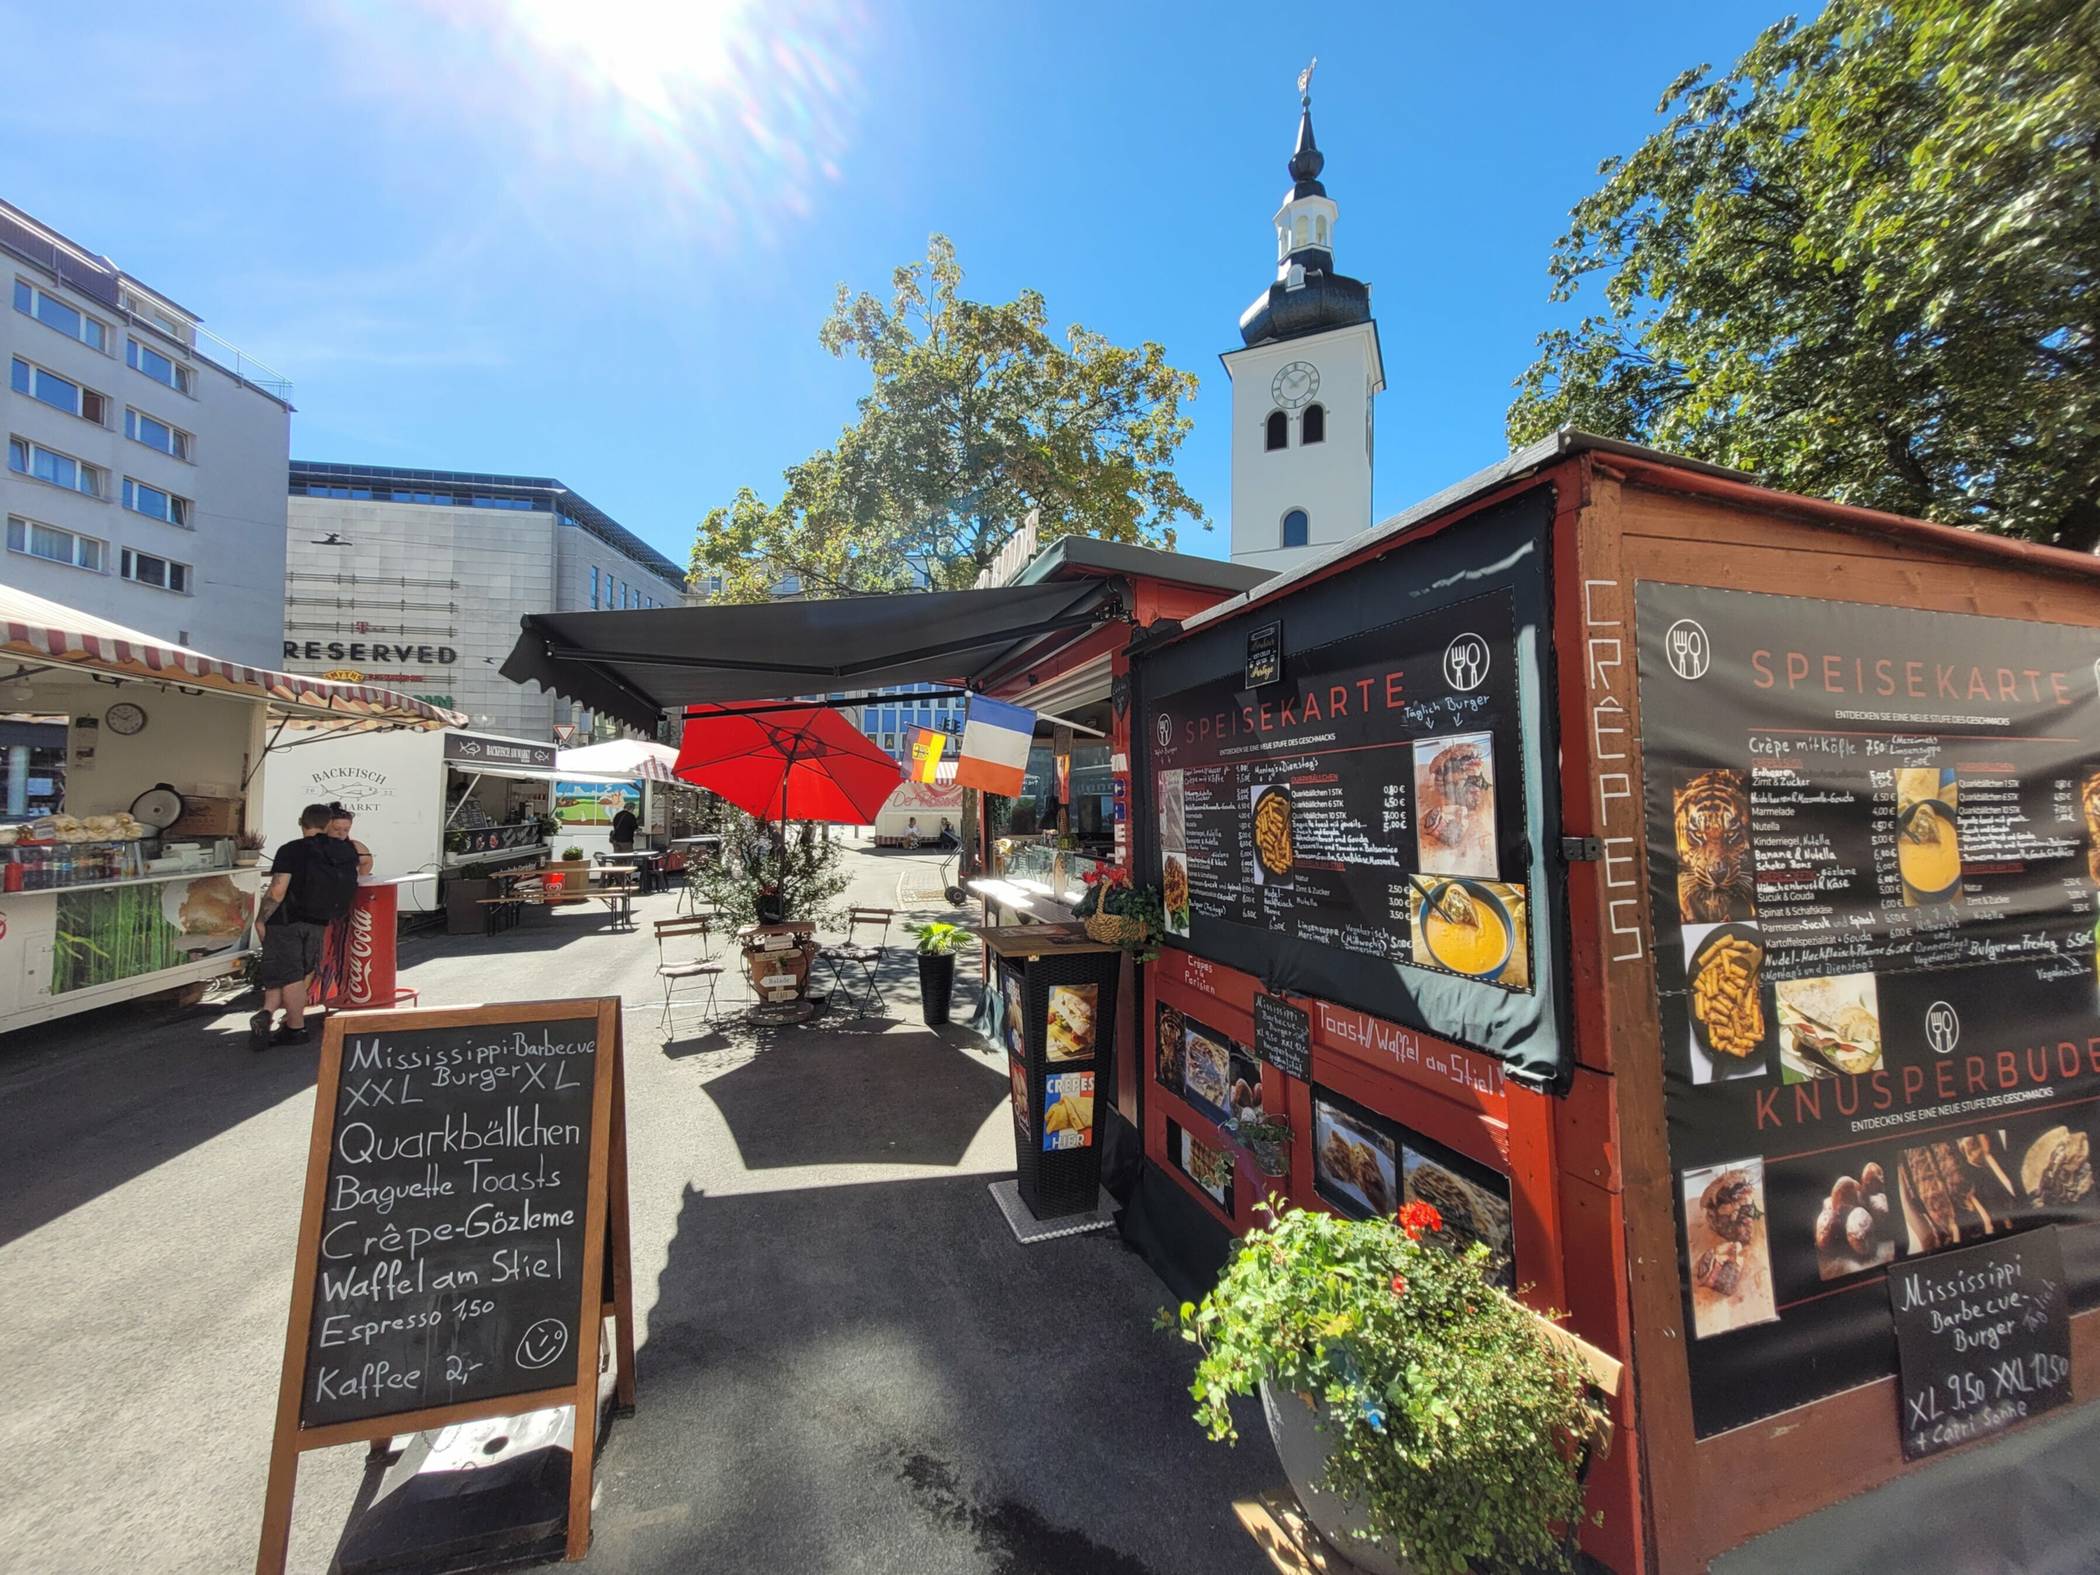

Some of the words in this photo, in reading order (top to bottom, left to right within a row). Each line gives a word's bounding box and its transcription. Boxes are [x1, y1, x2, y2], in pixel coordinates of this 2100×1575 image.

[283, 640, 457, 664] RESERVED
[1751, 649, 2076, 705] SPEISEKARTE
[1186, 671, 1405, 743] SPEISEKARTE
[1404, 701, 1441, 721] Täglich
[1444, 696, 1490, 712] Burger
[1834, 710, 1880, 721] ENTDECKEN
[1299, 733, 1336, 745] GESCHMACKS
[1796, 736, 1820, 751] mit
[1821, 738, 1857, 759] Köfte
[312, 767, 387, 785] BACKFISCH
[1752, 777, 1772, 787] Zimt
[1780, 775, 1811, 787] Zucker
[1291, 789, 1328, 798] Quarkbällchen
[1752, 807, 1795, 816] Marmelade
[1347, 833, 1369, 843] Gouda
[1752, 821, 1780, 832] Nutella
[1755, 850, 1792, 861] Banane
[1804, 848, 1838, 861] Nutella
[1755, 860, 1787, 871] Schoko
[1826, 878, 1850, 889] Käse
[1757, 892, 1783, 903] Sucuk
[1790, 890, 1815, 901] Gouda
[1758, 907, 1784, 918] Spinat
[1791, 905, 1834, 916] Schafskäse
[1765, 936, 1837, 949] Kartoffelspezialität
[1843, 930, 1873, 944] Gouda
[1968, 938, 2007, 961] Bulgur
[1426, 1056, 1447, 1076] am
[344, 1074, 424, 1117] XXL
[431, 1062, 522, 1092] Burger
[520, 1060, 581, 1093] XL
[1755, 1036, 2100, 1131] KNUSPERBUDE
[1850, 1114, 1904, 1133] ENTDECKEN
[1904, 1109, 1917, 1123] SIE
[1918, 1105, 1938, 1121] EINE
[1938, 1102, 1961, 1117] NEUE
[1961, 1097, 1986, 1114] STUFE
[1987, 1094, 2003, 1108] DES
[2003, 1086, 2054, 1105] GESCHMACKS
[339, 1103, 580, 1164] Quarkbällchen
[331, 1163, 456, 1215] Baguette
[464, 1153, 562, 1194] Toasts
[323, 1258, 424, 1302] Waffel
[432, 1270, 479, 1290] am
[491, 1238, 562, 1282] Stiel
[1900, 1253, 2022, 1312] Mississippi
[319, 1311, 443, 1349] Espresso
[1953, 1318, 2016, 1352] Burger
[315, 1360, 422, 1403] Kaffee
[1908, 1386, 1944, 1431] XL
[1991, 1357, 2034, 1398] XXL
[1916, 1432, 1927, 1451] +
[1931, 1414, 1975, 1443] Capri
[1983, 1400, 2028, 1427] Sonne
